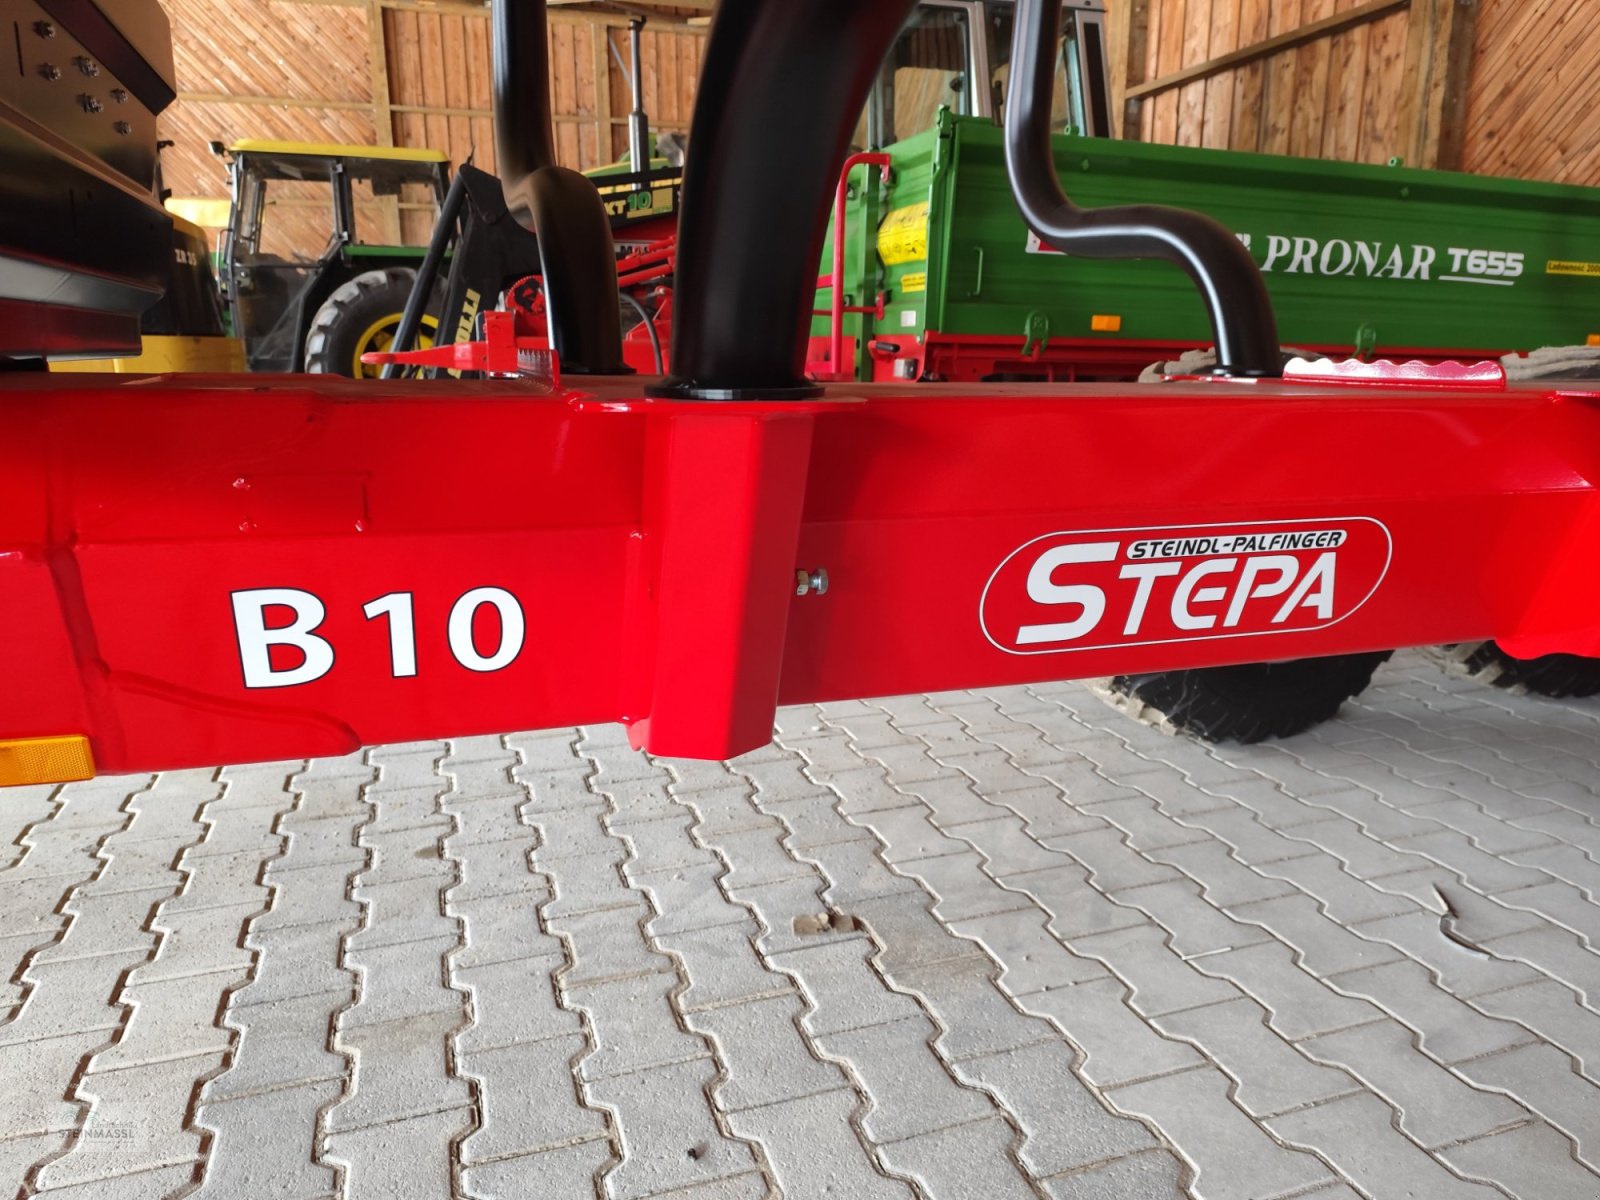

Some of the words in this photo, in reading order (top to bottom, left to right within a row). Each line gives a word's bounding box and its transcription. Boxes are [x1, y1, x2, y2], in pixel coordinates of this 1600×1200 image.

[627, 191, 652, 212] 10
[1260, 235, 1436, 281] PRONAR
[1447, 247, 1525, 277] T655
[1131, 530, 1343, 558] STEINDL-PALFINGER
[1015, 540, 1337, 645] STEPA
